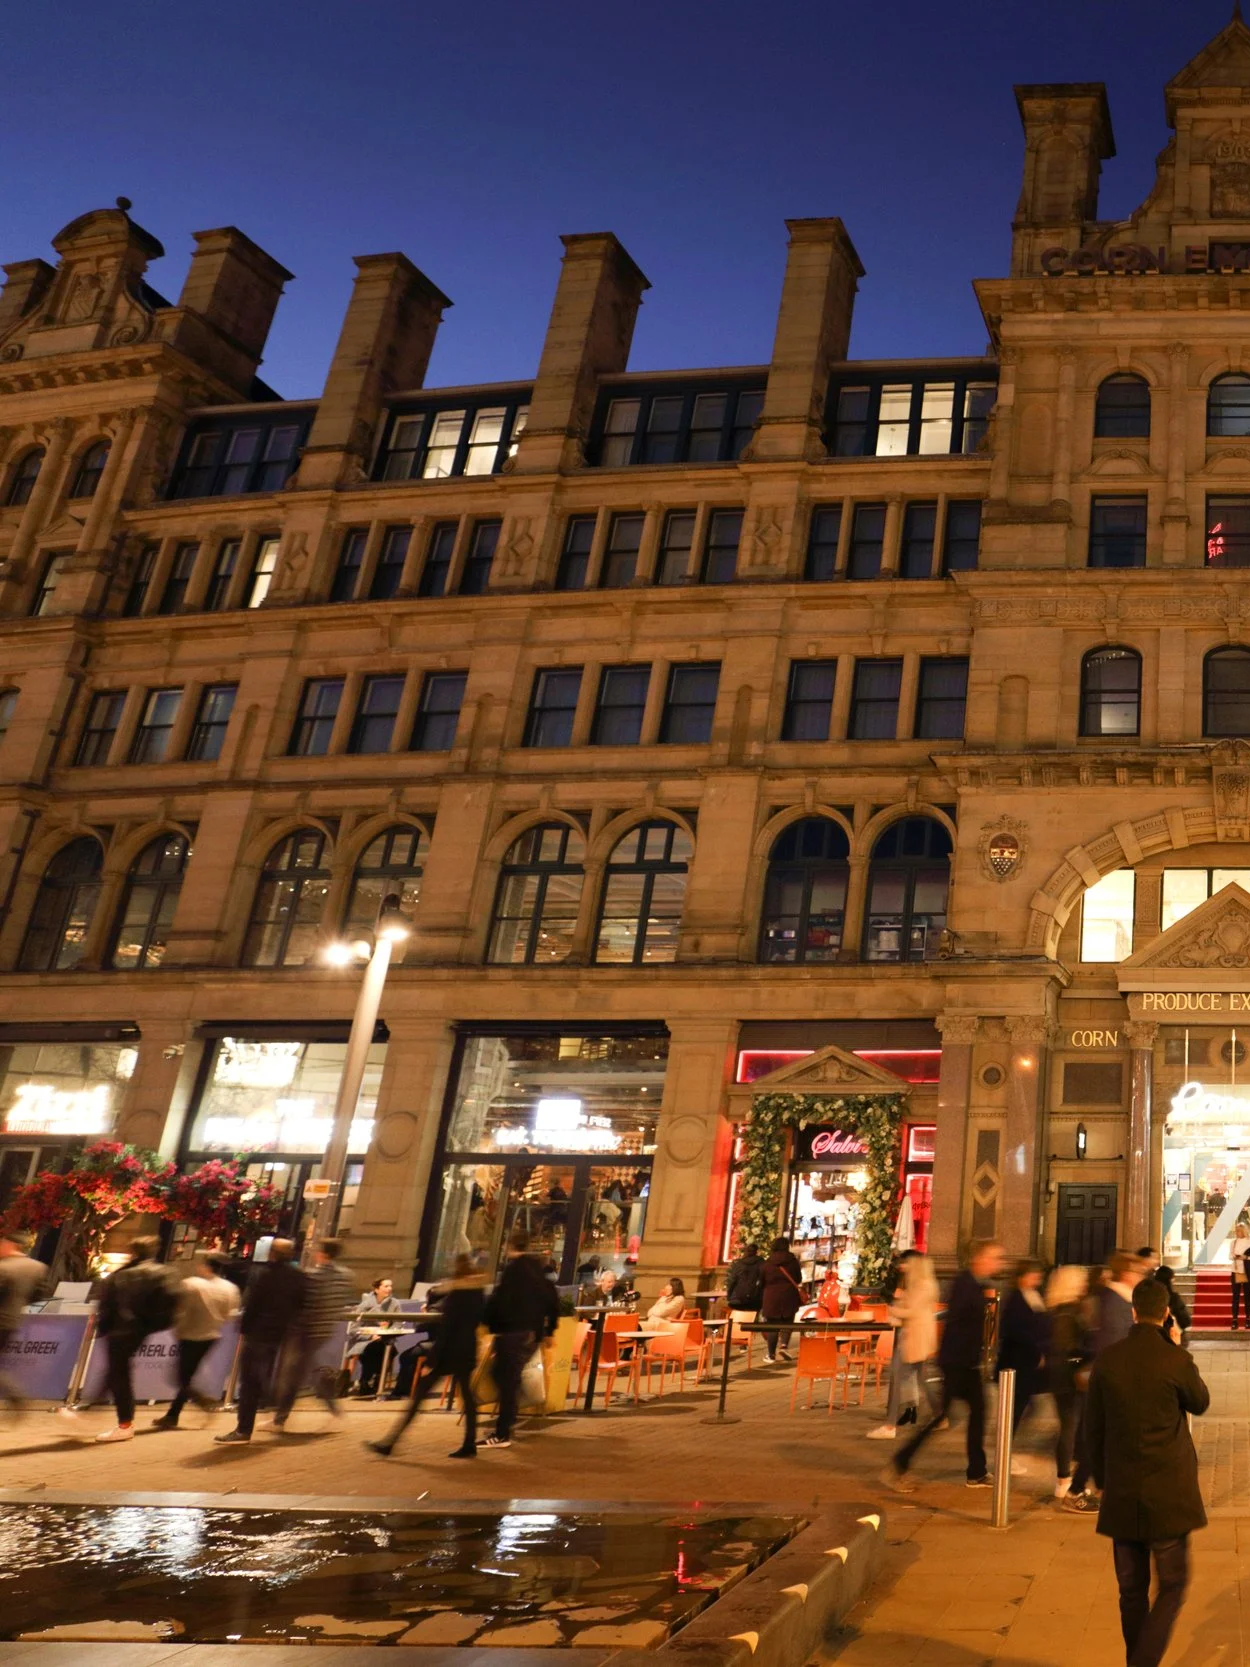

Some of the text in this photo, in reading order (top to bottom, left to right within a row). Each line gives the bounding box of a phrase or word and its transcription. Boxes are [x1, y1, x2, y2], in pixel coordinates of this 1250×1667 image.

[1040, 245, 1166, 275] CORN
[1142, 993, 1222, 1011] PRODUCE
[1071, 1030, 1118, 1047] CORN
[24, 1341, 60, 1354] GREEK
[139, 1344, 167, 1357] REAL
